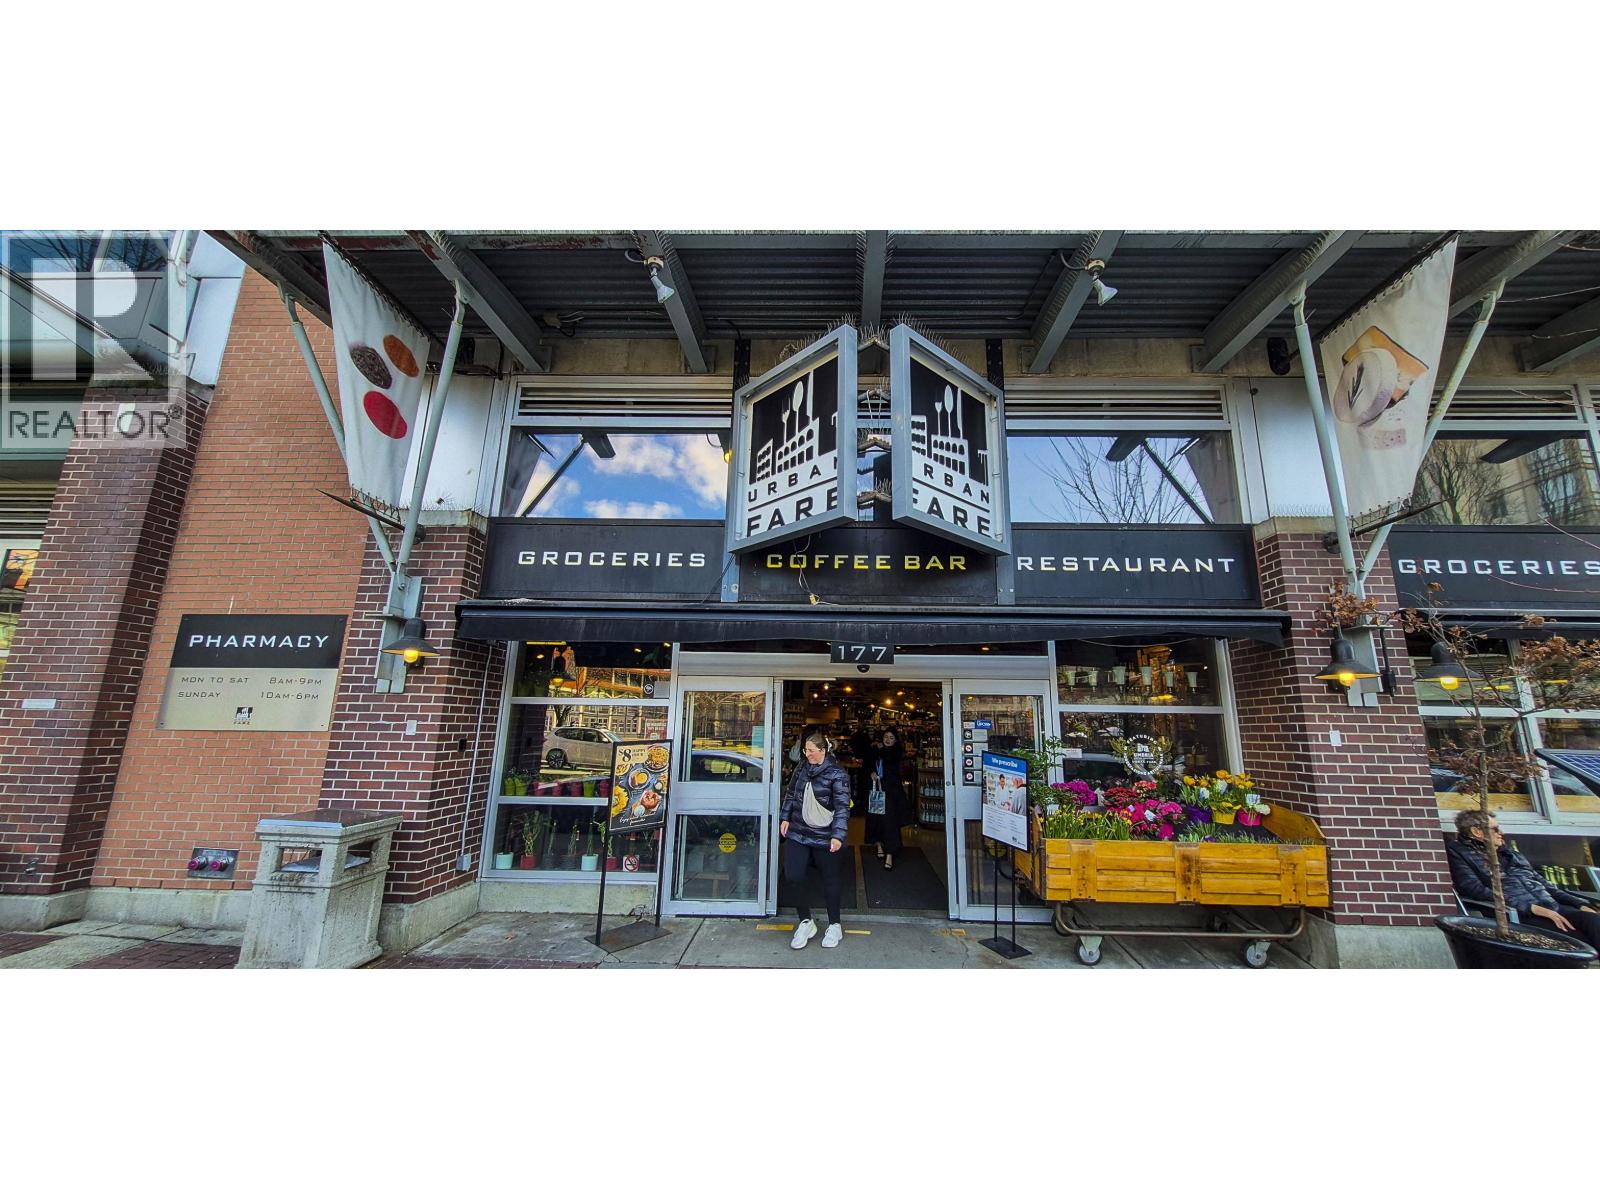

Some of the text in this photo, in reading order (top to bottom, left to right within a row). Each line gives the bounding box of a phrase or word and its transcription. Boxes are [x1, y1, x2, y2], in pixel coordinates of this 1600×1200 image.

[923, 463, 990, 504] RBAN
[746, 487, 837, 537] FARE
[518, 551, 705, 567] GROCERIES
[766, 554, 967, 570] COFFEE BAR
[1016, 556, 1235, 573] RESTAURANT
[1398, 559, 1600, 575] GROCERIES
[188, 634, 329, 648] PHARMACY
[838, 645, 887, 661] 177
[269, 677, 322, 685] 8AM-9PM
[261, 692, 319, 700] 10AM-6PM
